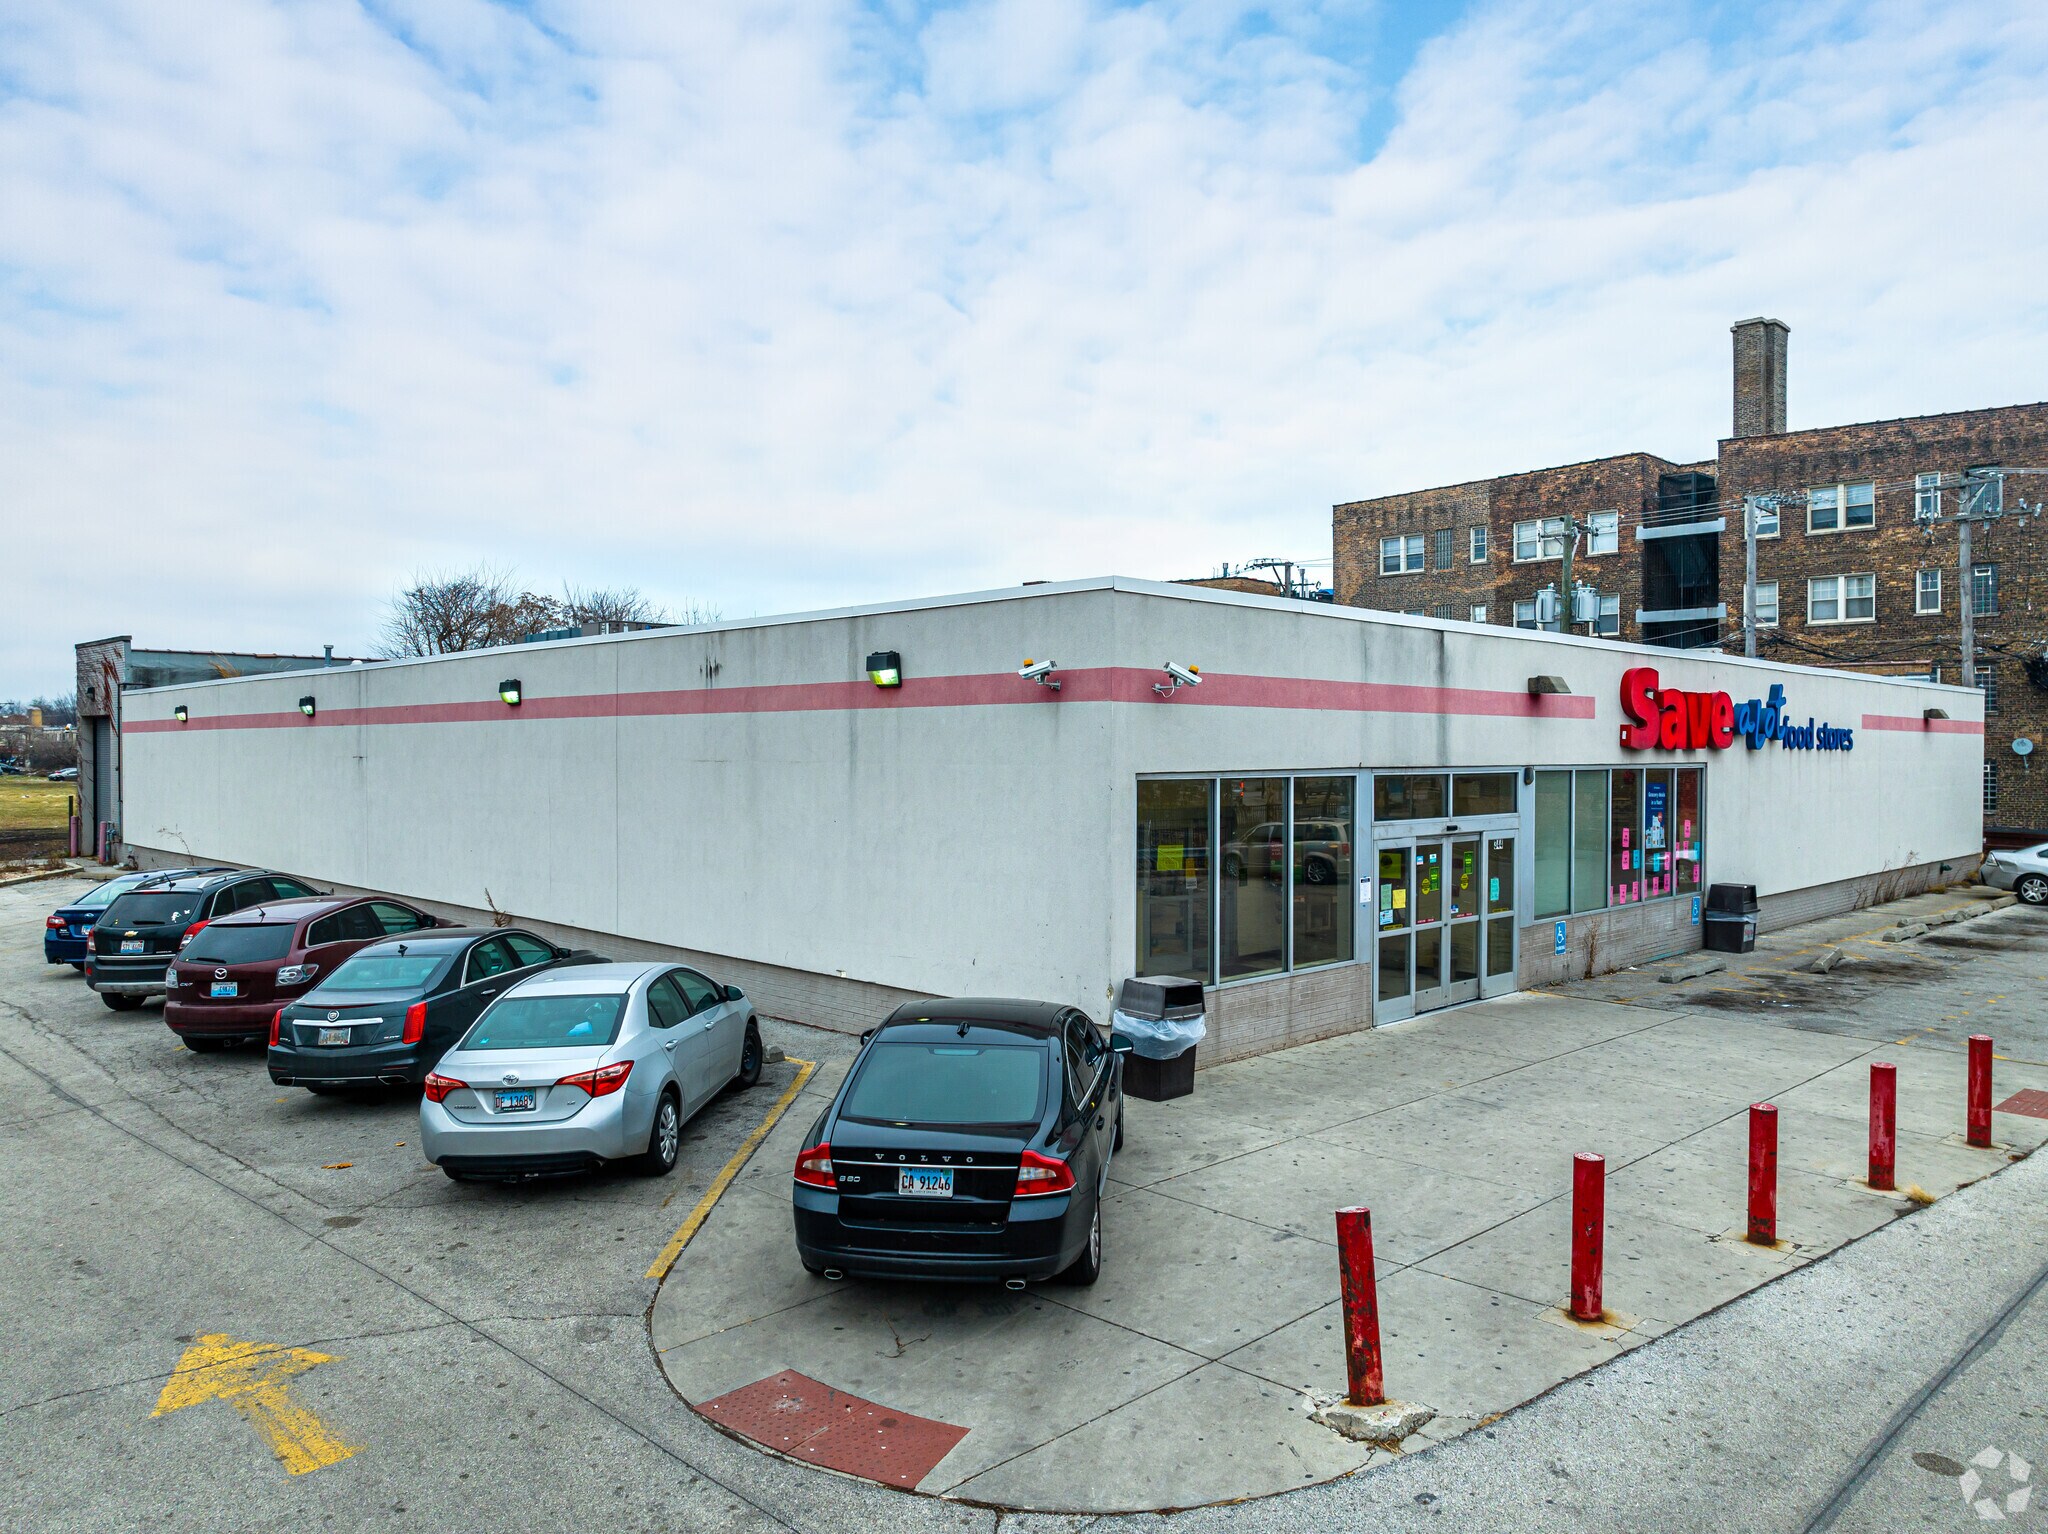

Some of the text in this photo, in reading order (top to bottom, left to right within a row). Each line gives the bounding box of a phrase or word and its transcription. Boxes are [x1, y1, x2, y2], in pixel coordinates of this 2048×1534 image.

[1620, 667, 1734, 749] Save
[1783, 715, 1853, 751] food stores
[875, 1153, 973, 1163] VOLVO
[901, 1175, 951, 1191] CA 91246
